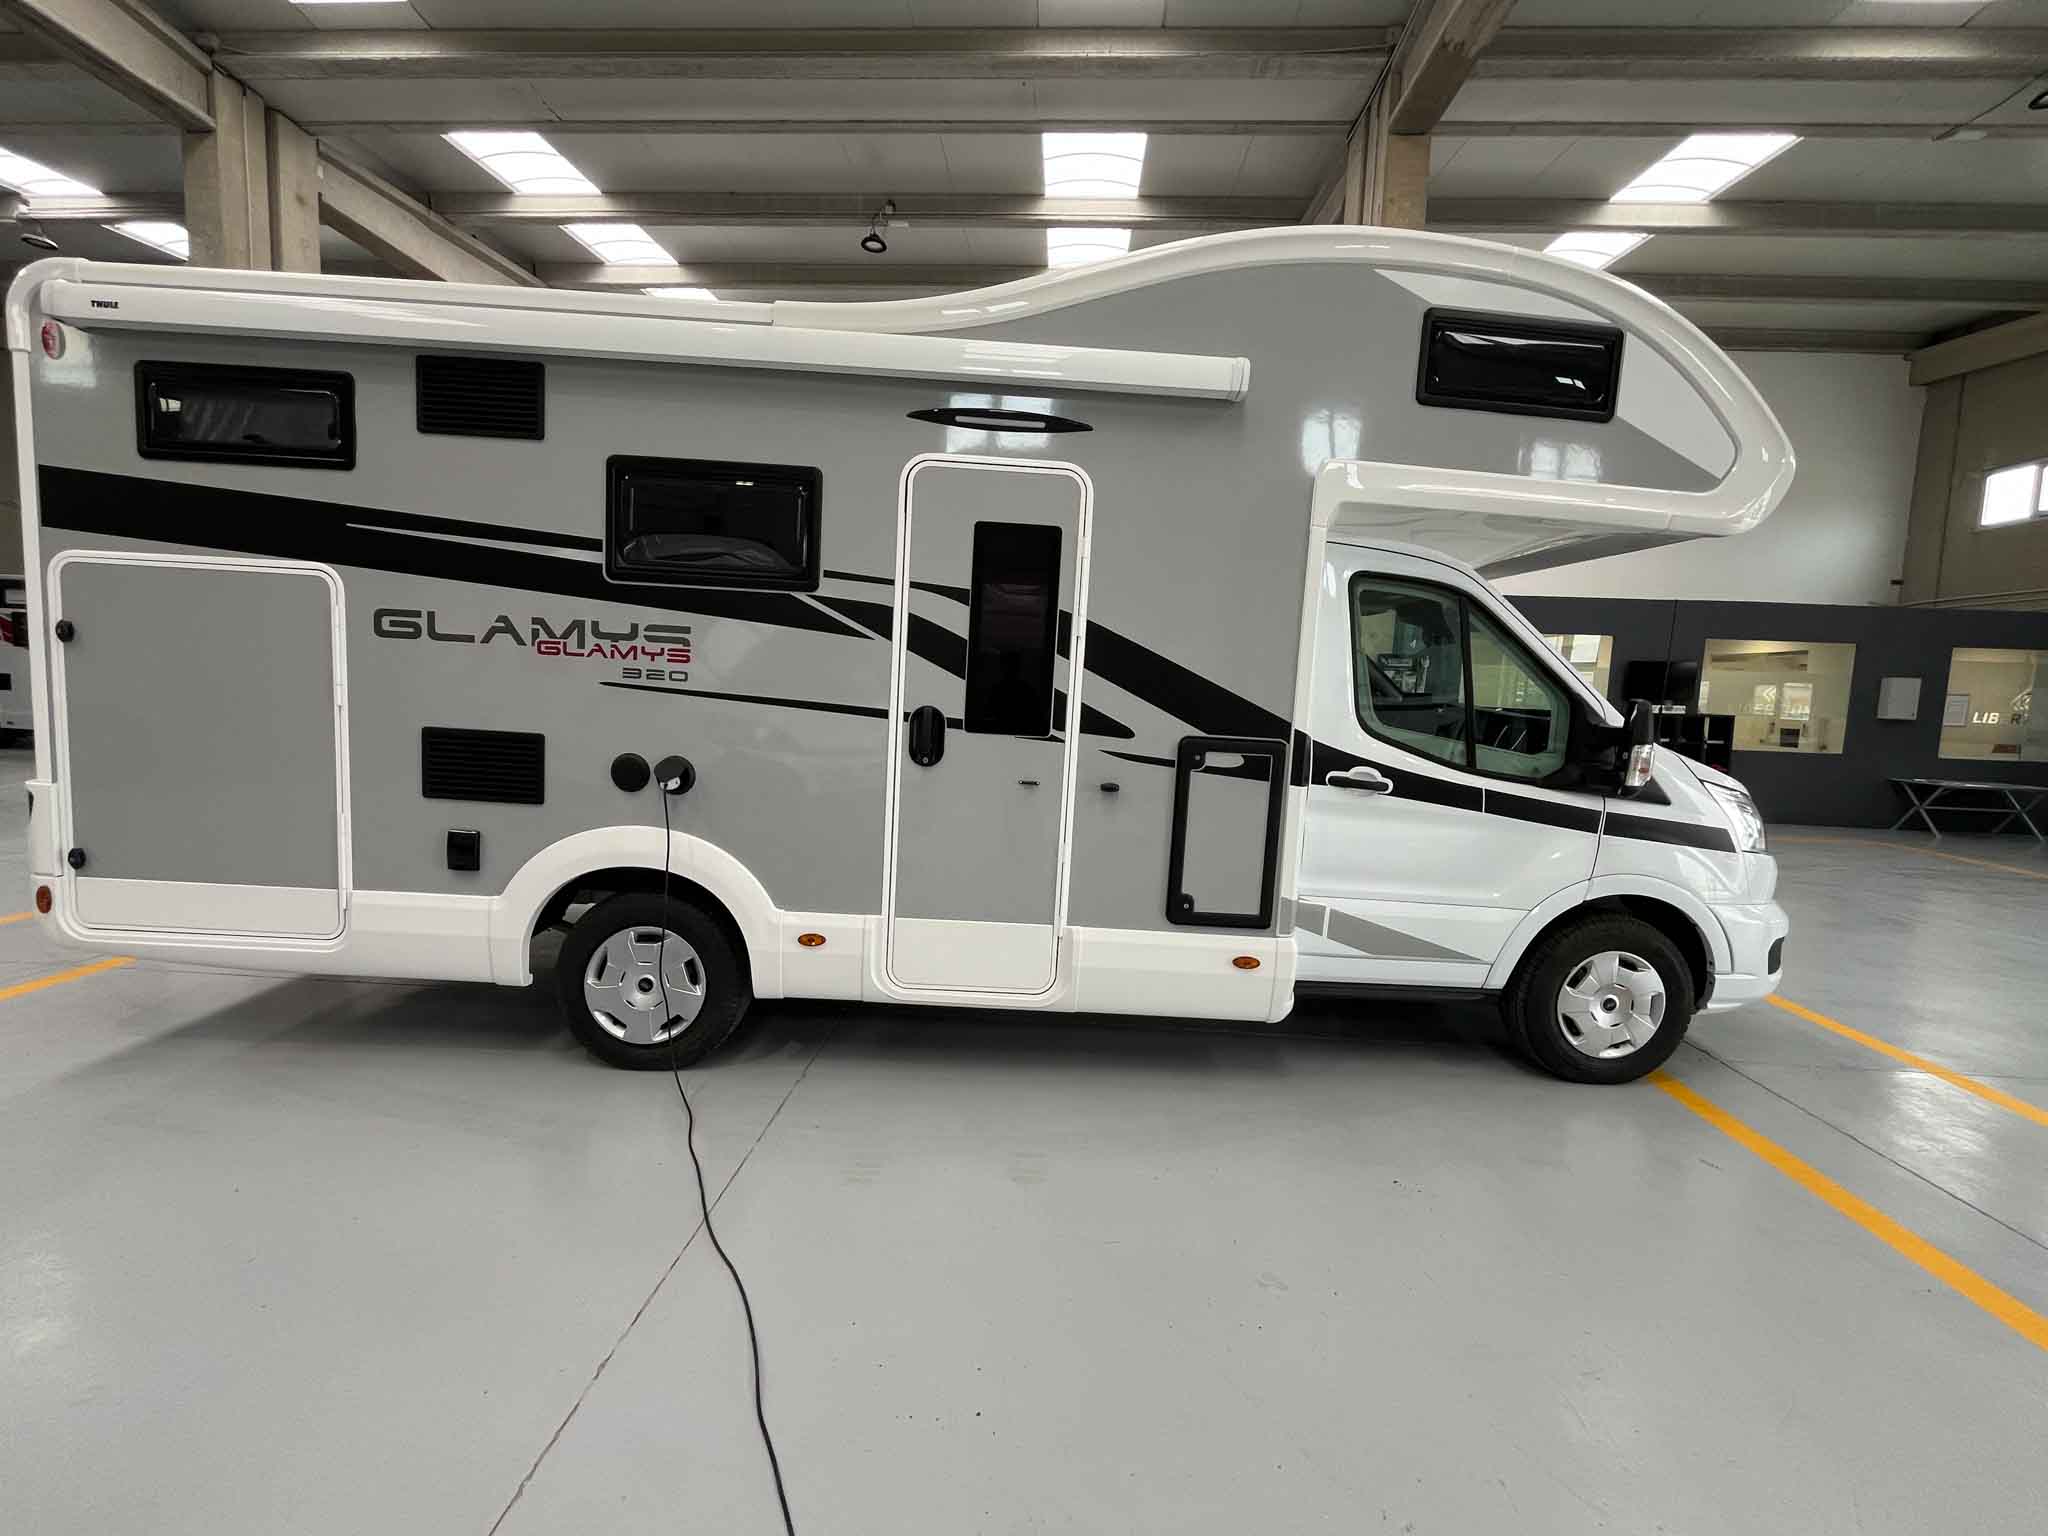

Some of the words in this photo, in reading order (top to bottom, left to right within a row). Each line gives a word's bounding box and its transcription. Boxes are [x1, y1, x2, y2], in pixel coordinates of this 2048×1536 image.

[373, 608, 692, 650] GLAMYS
[536, 640, 691, 664] GLAMYS
[622, 667, 689, 682] 320
